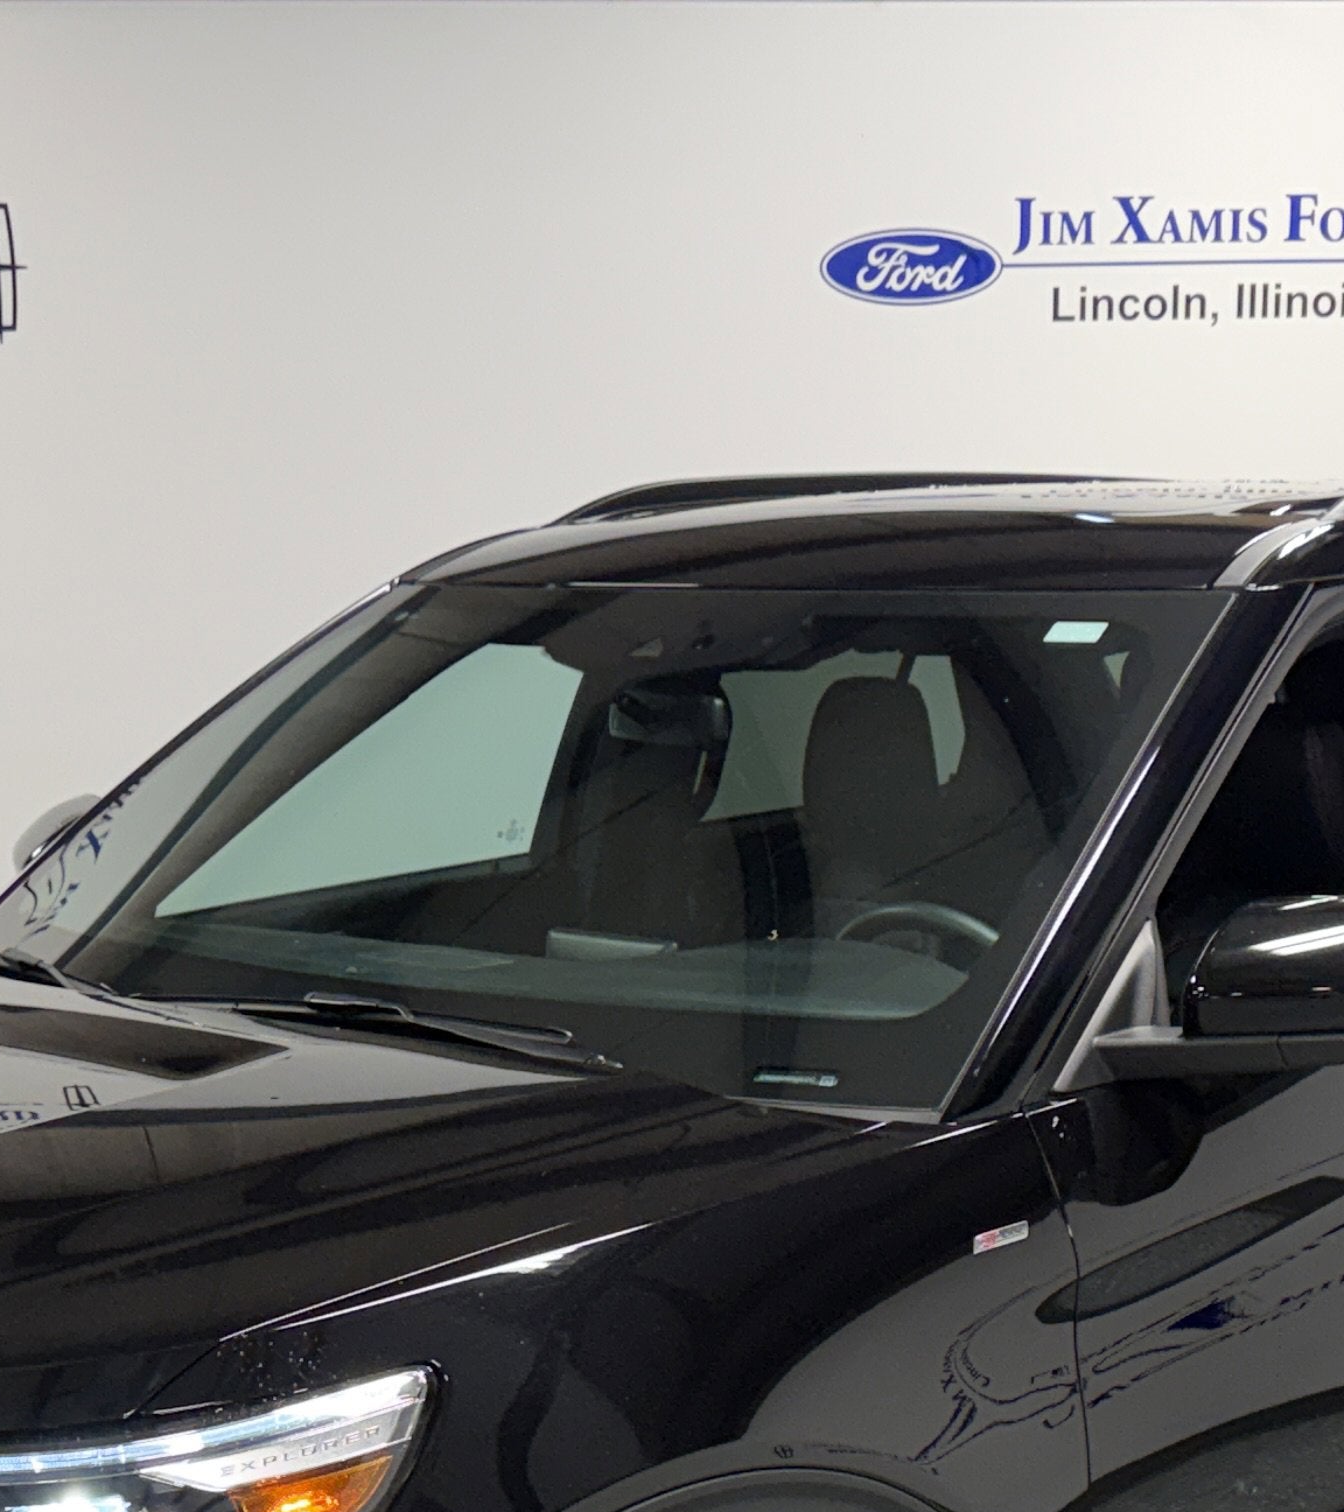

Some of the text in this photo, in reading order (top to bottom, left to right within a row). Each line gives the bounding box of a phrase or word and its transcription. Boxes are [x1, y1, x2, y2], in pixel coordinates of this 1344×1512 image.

[1012, 196, 1096, 255] JIM
[1110, 194, 1269, 246] XAMIS
[856, 240, 965, 294] Ford
[1052, 284, 1221, 325] Lincoln,
[219, 1424, 381, 1478] EXPLORER
